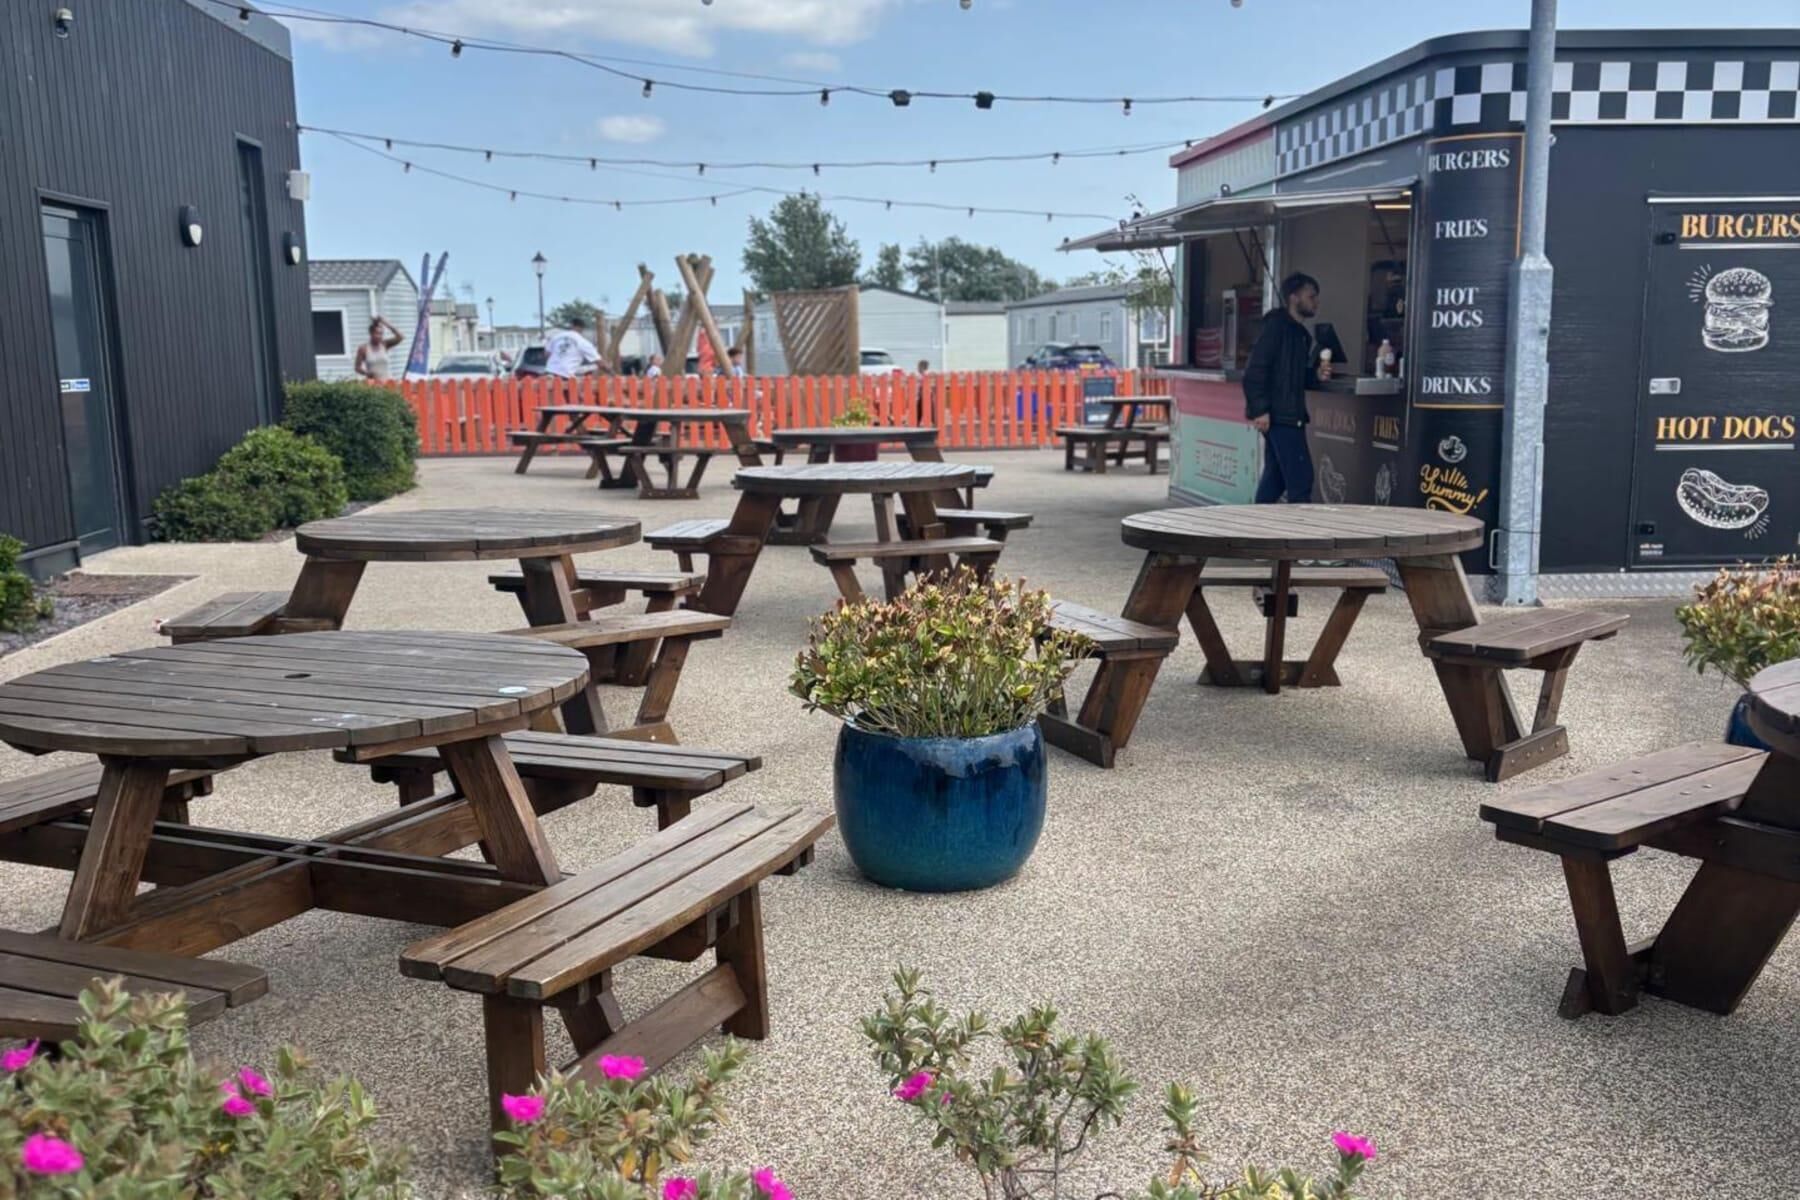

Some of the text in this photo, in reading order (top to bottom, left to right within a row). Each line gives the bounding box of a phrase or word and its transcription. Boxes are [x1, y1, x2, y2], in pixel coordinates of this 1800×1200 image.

[1428, 148, 1510, 172] BURGERS
[1434, 218, 1488, 239] FRIES
[1680, 212, 1800, 239] BURGERS
[1436, 287, 1480, 306] HOT
[1431, 309, 1484, 328] DOGS
[1421, 375, 1492, 394] DRINKS
[1656, 415, 1796, 440] HOT DOGS
[1420, 464, 1489, 513] Yummy!
